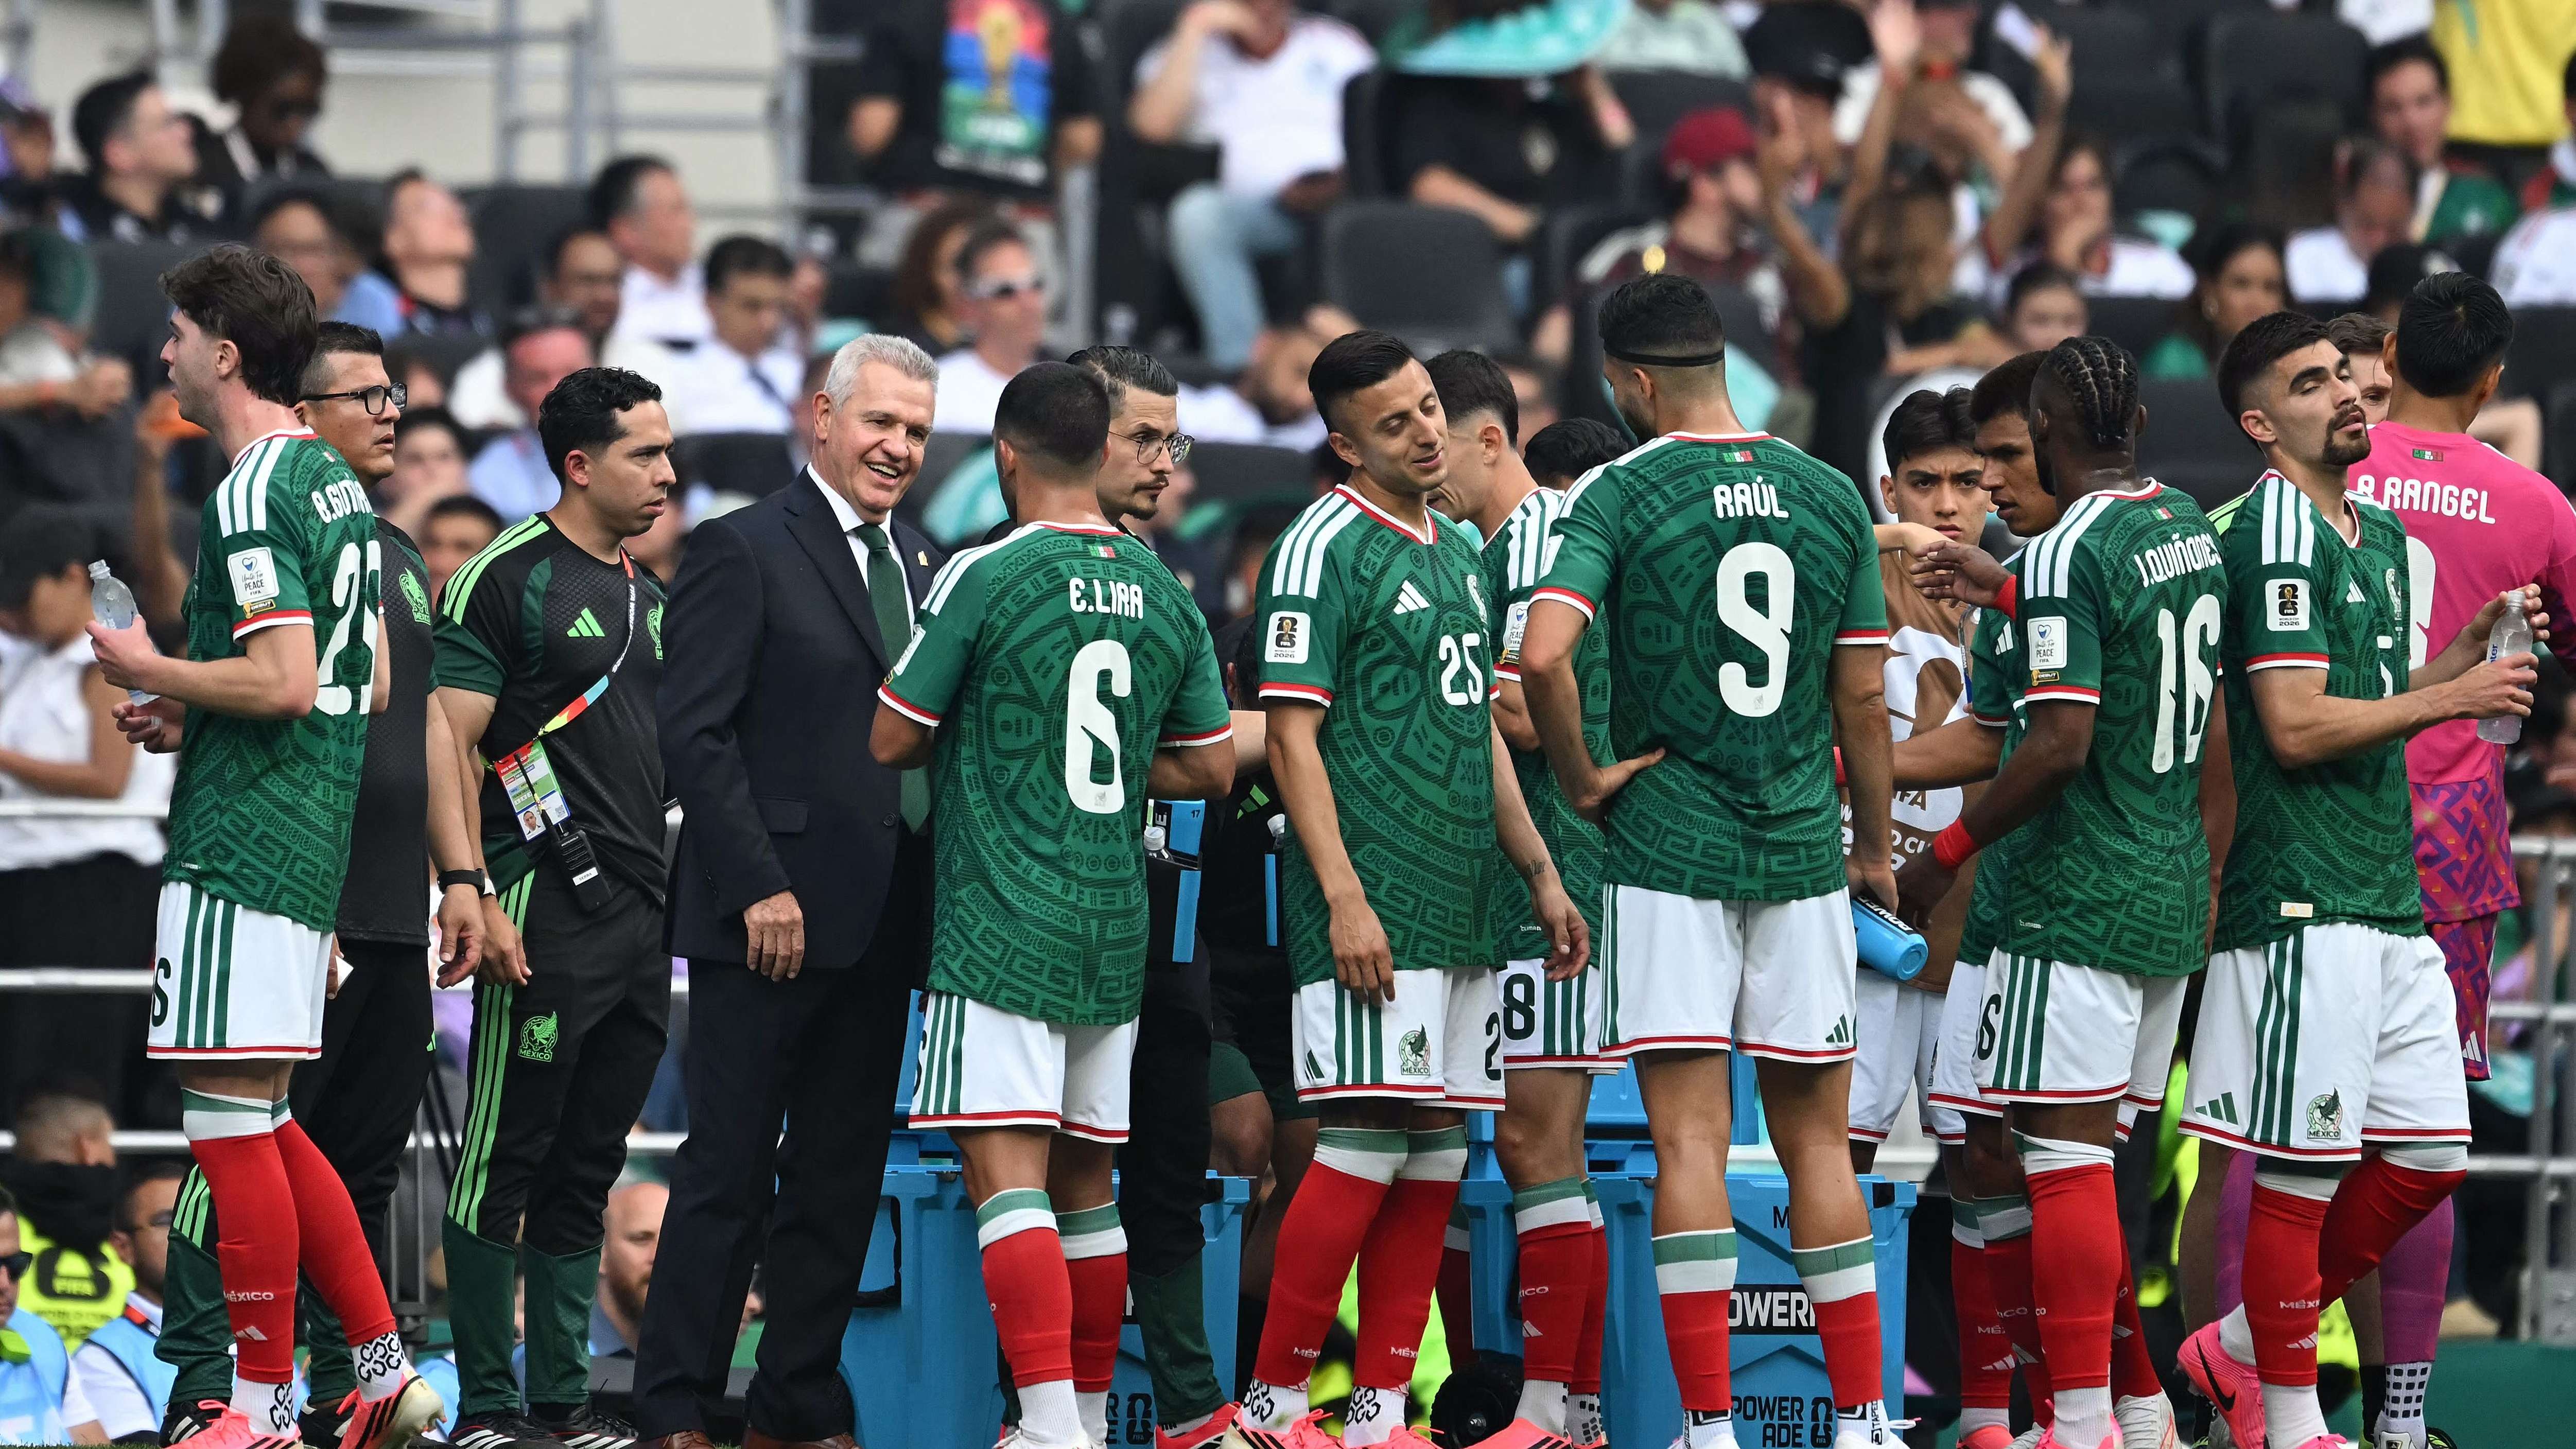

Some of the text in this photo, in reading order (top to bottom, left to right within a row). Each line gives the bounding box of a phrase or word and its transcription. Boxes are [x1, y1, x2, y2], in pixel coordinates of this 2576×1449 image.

[1713, 475, 1789, 518] RAÚL
[2134, 532, 2223, 588] J.QUIÑONES
[244, 579, 264, 591] PEACE
[1069, 577, 1143, 619] E.LIRA
[1716, 542, 1796, 718] 9
[1439, 633, 1484, 706] 25
[2036, 648, 2055, 658] PEACE
[2151, 593, 2221, 773] 16
[1065, 639, 1132, 814] 6
[1191, 809, 1201, 818] 17
[1503, 972, 1536, 1041] 8
[519, 1049, 550, 1060] MÉXICO
[1402, 1066, 1429, 1074] MÉXICO
[2308, 1128, 2340, 1138] MÉXICO
[1728, 1291, 1816, 1328] OWER
